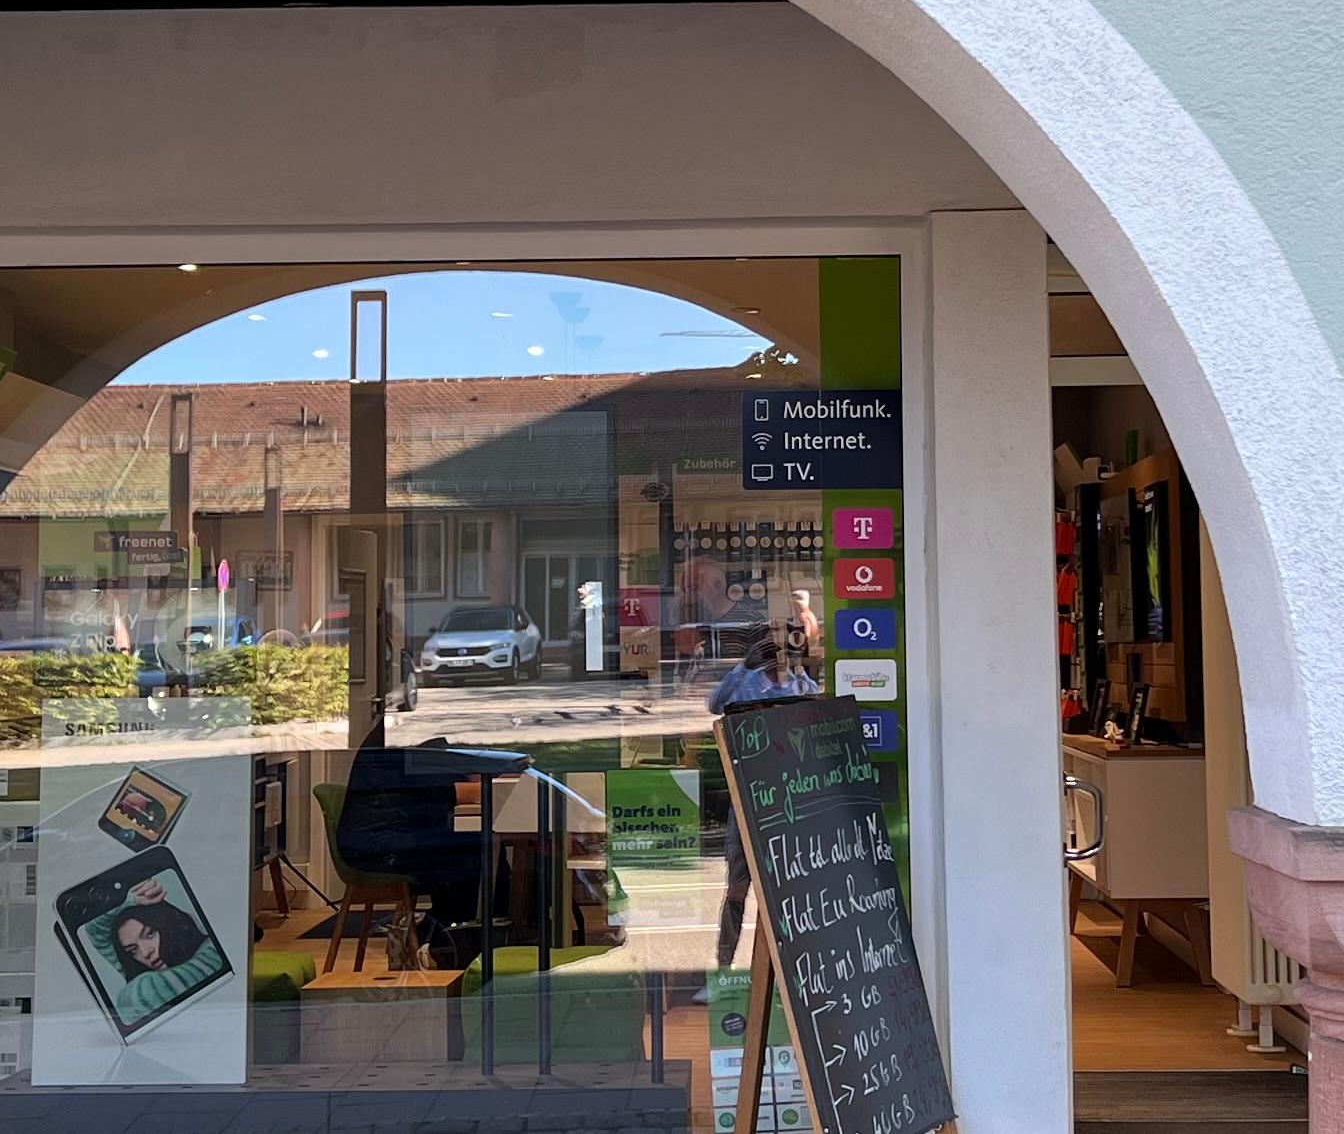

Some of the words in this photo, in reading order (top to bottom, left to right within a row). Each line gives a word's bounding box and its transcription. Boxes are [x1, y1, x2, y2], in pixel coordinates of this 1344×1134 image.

[783, 399, 892, 420] Mobilfunk.
[783, 431, 872, 451] Internet.
[683, 457, 736, 470] Zubehör
[783, 463, 815, 482] TV.
[118, 536, 173, 548] freenet
[846, 584, 883, 592] vodafone
[862, 723, 878, 739] &1
[750, 780, 777, 812] Für
[782, 768, 820, 824] jeden
[824, 766, 843, 787] was
[612, 805, 654, 819] Darfs
[657, 804, 681, 817] ein
[612, 837, 654, 851] mehr
[656, 836, 697, 849] sein?
[768, 833, 809, 888] Flat
[782, 892, 820, 943] Flat
[795, 950, 835, 1007] Flat
[830, 948, 856, 982] ins
[856, 925, 909, 974] Internet
[841, 993, 853, 1015] 3
[861, 984, 881, 1009] GB
